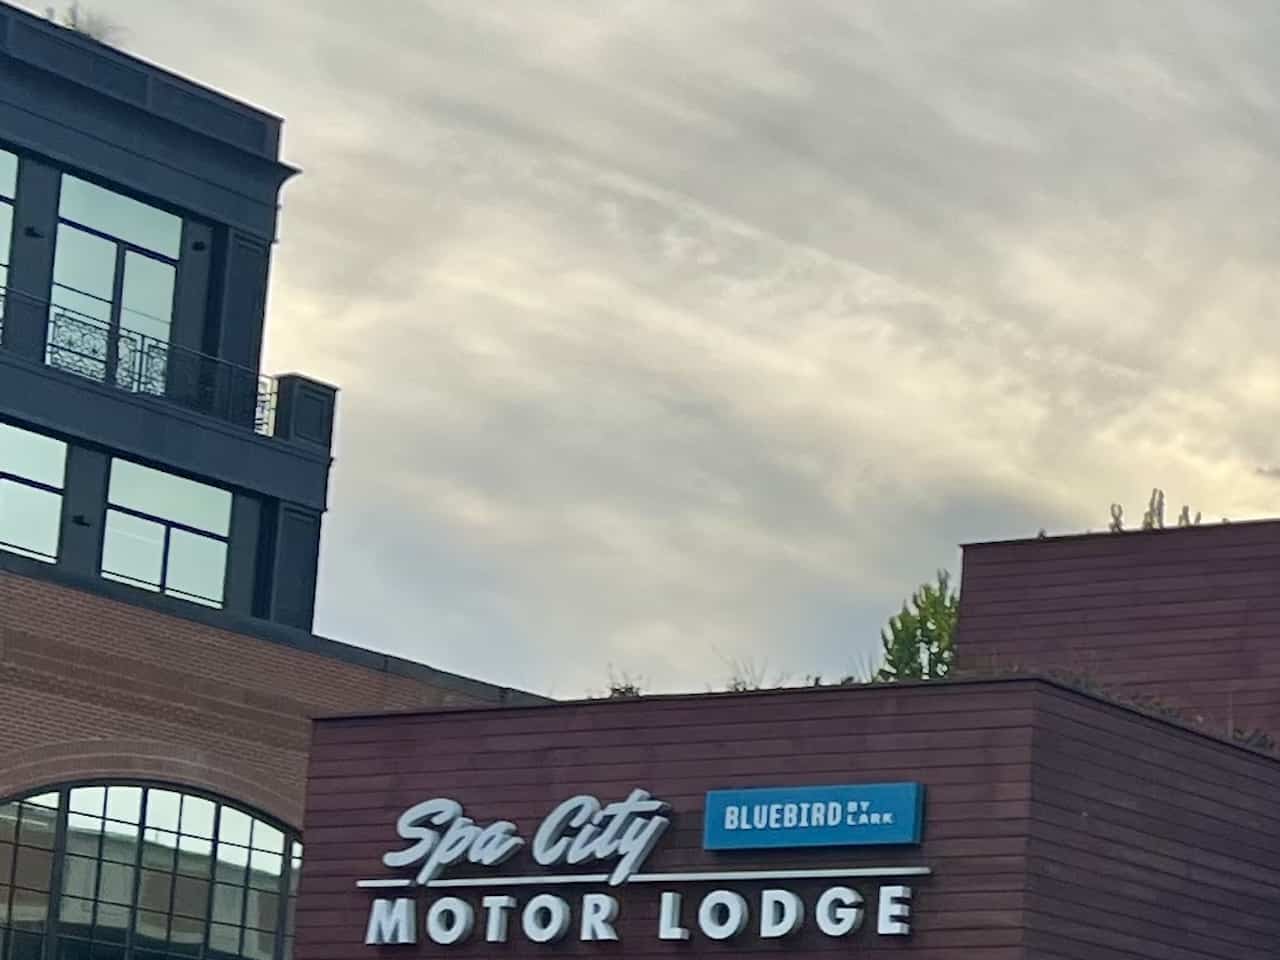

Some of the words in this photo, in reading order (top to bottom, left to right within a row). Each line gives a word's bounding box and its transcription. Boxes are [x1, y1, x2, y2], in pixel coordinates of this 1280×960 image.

[724, 801, 842, 830] BLUEBIRD
[846, 813, 894, 826] LARK
[847, 801, 872, 813] BY
[383, 797, 525, 886] Spa
[533, 789, 673, 887] City
[365, 894, 620, 945] MOTOR
[658, 885, 913, 940] LODGE
